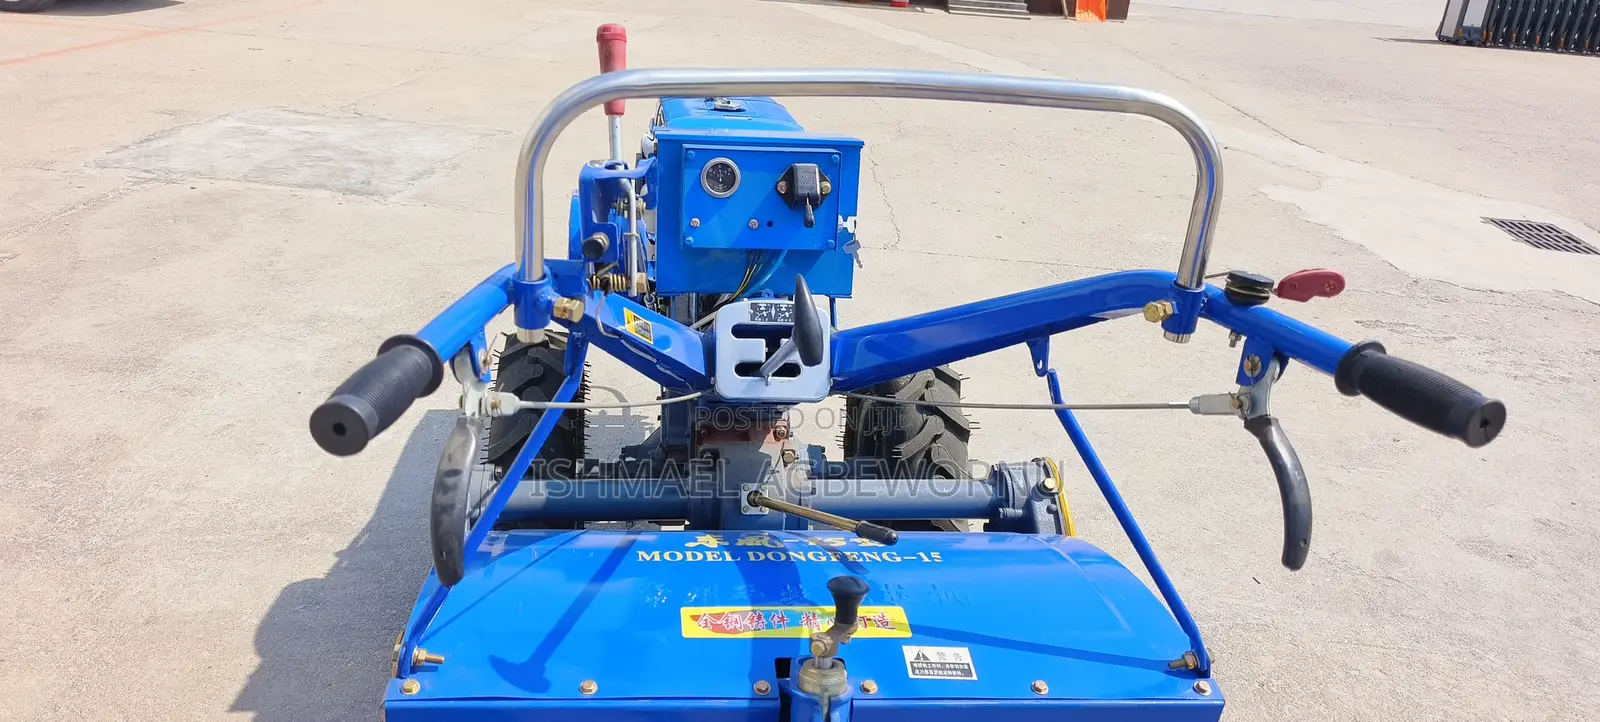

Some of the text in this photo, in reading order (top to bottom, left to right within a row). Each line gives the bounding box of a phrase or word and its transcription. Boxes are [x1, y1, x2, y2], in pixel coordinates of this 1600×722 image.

[636, 550, 944, 563] MODEL DONGFENG-15
[697, 610, 789, 632] 全钢铸件
